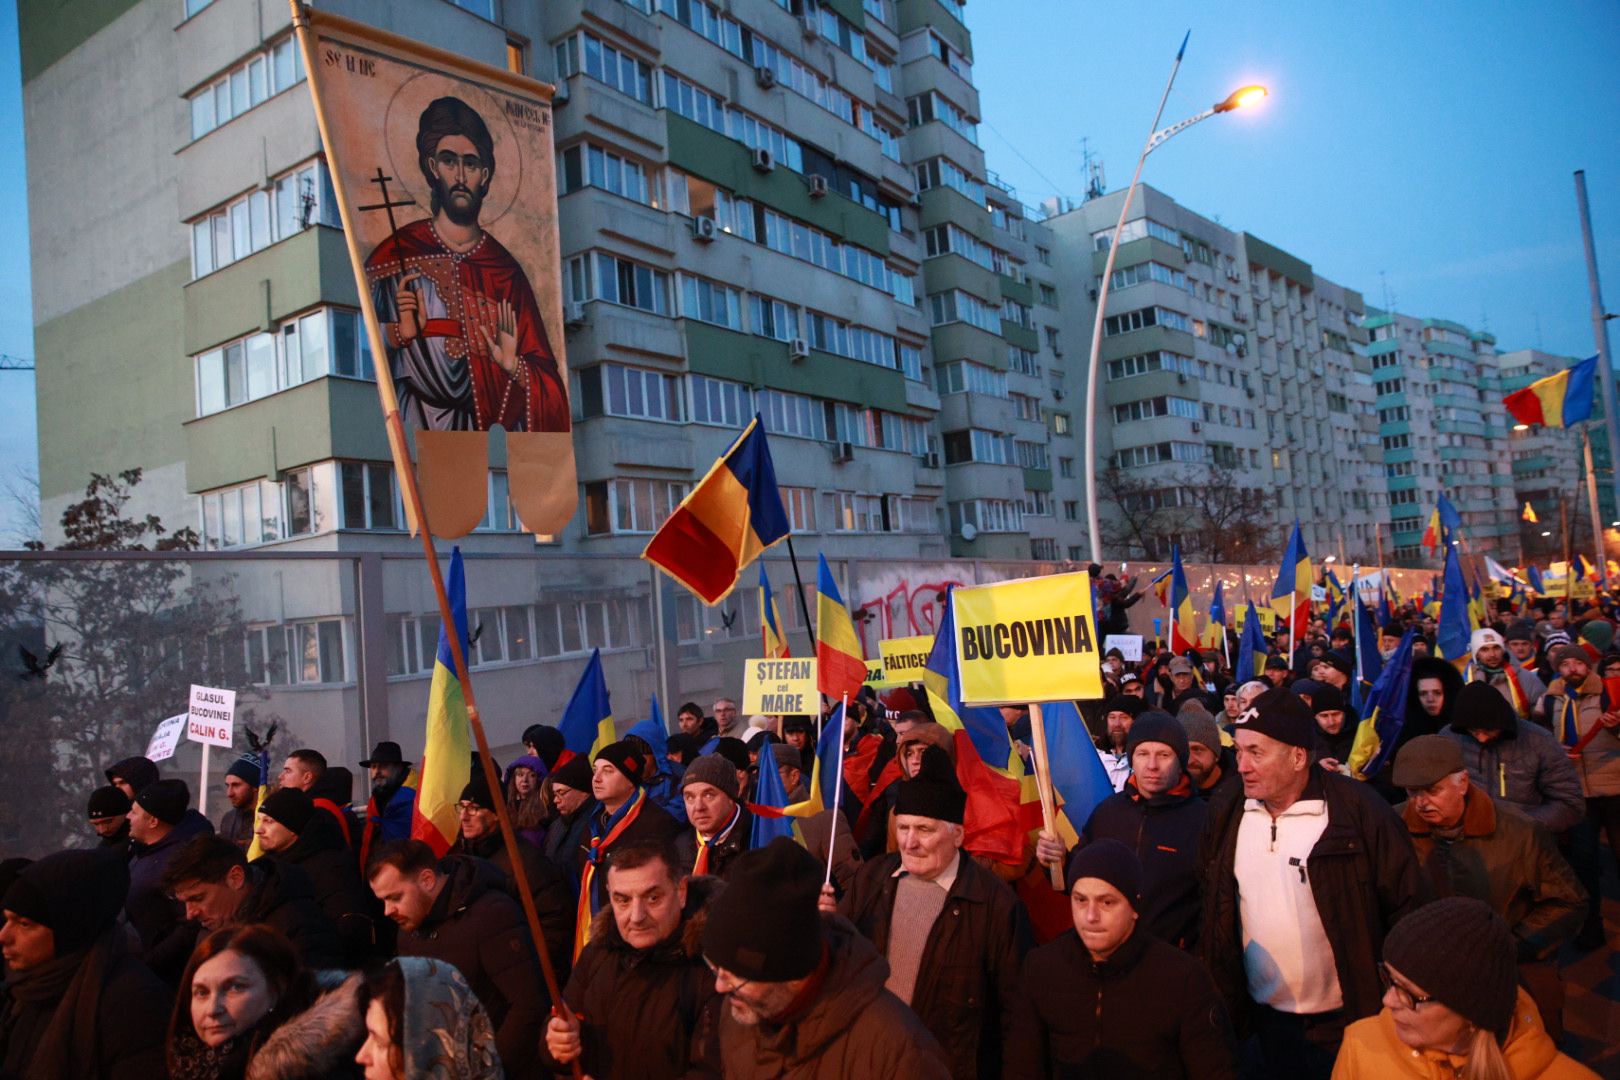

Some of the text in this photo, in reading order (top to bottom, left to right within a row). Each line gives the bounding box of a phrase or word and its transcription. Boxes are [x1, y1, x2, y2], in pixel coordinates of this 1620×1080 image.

[961, 615, 1093, 660] BUCOVINA
[777, 683, 789, 692] cel
[196, 692, 225, 704] GLASUL
[761, 694, 803, 712] MARE
[191, 706, 231, 721] BUCOVINEI
[190, 722, 229, 741] CALIN G.
